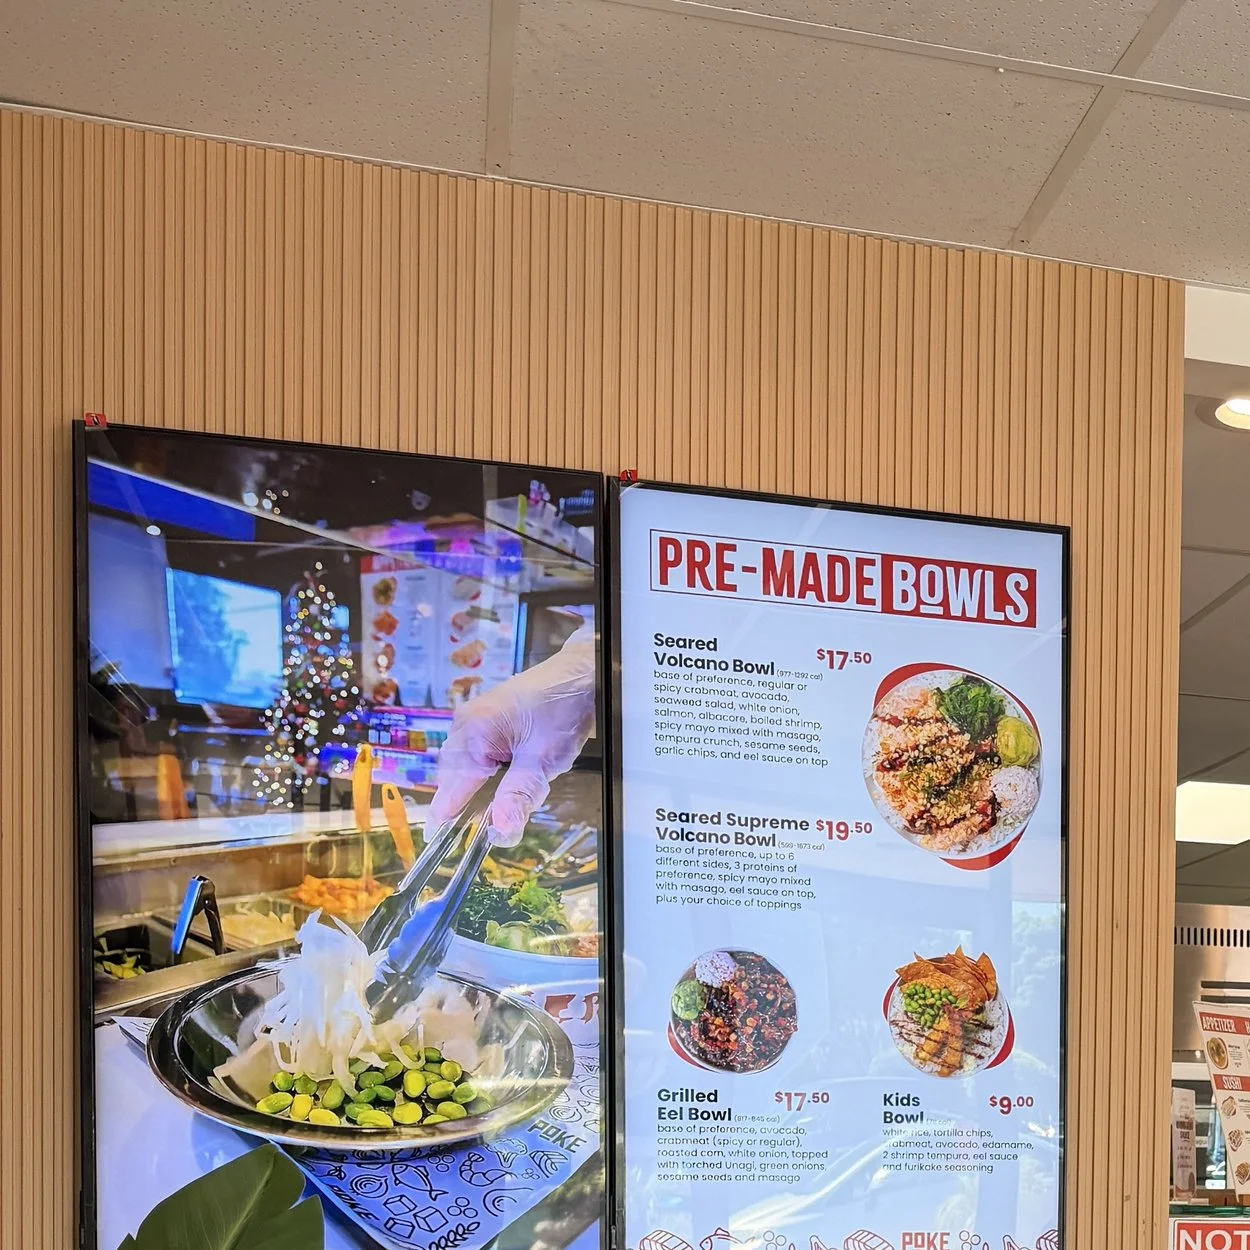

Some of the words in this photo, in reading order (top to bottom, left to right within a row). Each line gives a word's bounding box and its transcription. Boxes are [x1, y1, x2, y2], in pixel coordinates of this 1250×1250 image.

[659, 536, 877, 606] PRE-MADE
[891, 562, 1028, 622] BOWLS
[654, 633, 718, 651] Seared
[654, 652, 729, 672] Volcano
[733, 659, 775, 675] Bowl
[817, 648, 872, 670] $17.50
[655, 708, 696, 719] salmon,
[699, 712, 747, 724] albacore,
[751, 715, 782, 726] boiled
[785, 718, 822, 731] shrimp,
[655, 746, 684, 756] garlic
[687, 747, 718, 759] chips,
[721, 751, 740, 759] and
[744, 752, 759, 761] eel
[762, 755, 792, 764] sauce
[796, 757, 808, 765] on
[811, 758, 828, 767] top
[656, 808, 721, 826] Seared
[727, 813, 809, 832] Supreme
[656, 827, 730, 844] Volcano
[735, 832, 776, 847] Bowl
[816, 820, 872, 841] $19.50
[656, 894, 677, 904] plus
[681, 897, 704, 906] your
[707, 897, 741, 907] choice
[744, 899, 754, 907] of
[757, 899, 802, 911] toppings
[1202, 1016, 1236, 1032] APPETIZER
[1222, 1076, 1242, 1089] SUSHI
[658, 1088, 718, 1102] Grilled
[775, 1092, 829, 1112] $17.50
[883, 1093, 920, 1106] Kids
[658, 1107, 683, 1120] Eel
[689, 1108, 731, 1121] Bowl
[989, 1096, 1034, 1115] $9.00
[883, 1111, 923, 1124] Bowl
[528, 1119, 587, 1153] POKE
[891, 1152, 924, 1161] shrimp
[927, 1152, 970, 1162] tempura,
